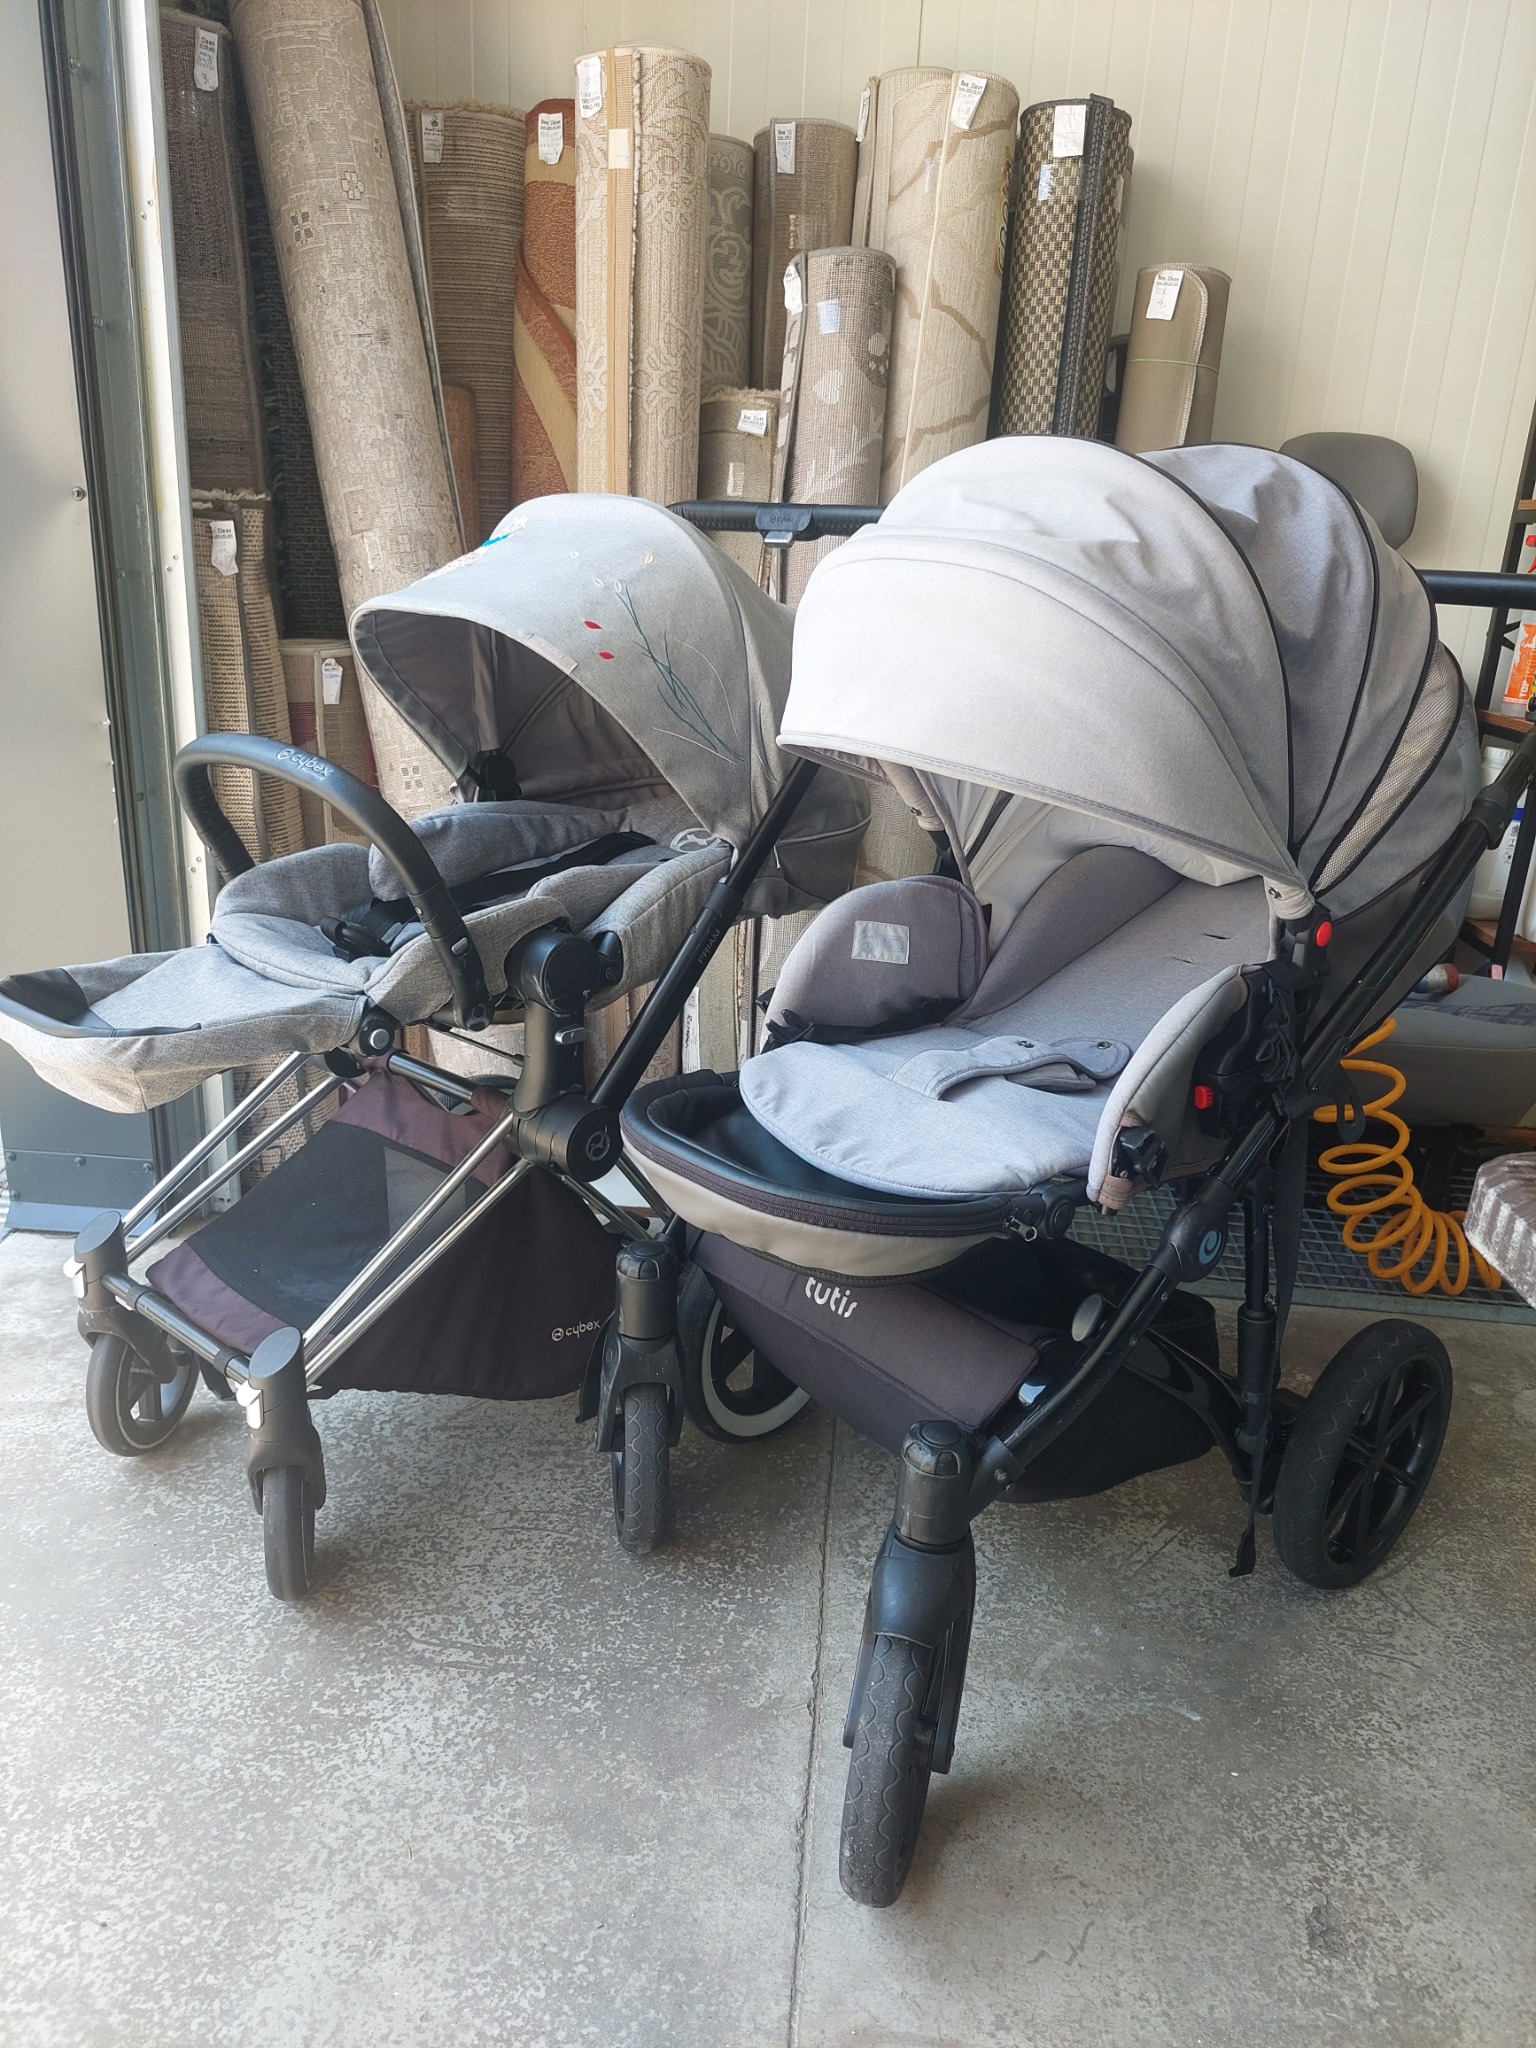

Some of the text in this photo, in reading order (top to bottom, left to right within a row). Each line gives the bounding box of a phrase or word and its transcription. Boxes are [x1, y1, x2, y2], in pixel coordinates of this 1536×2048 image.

[291, 754, 334, 777] cybex
[697, 928, 721, 964] PRIAM
[805, 1276, 858, 1318] tutis
[565, 1319, 601, 1339] cybex
